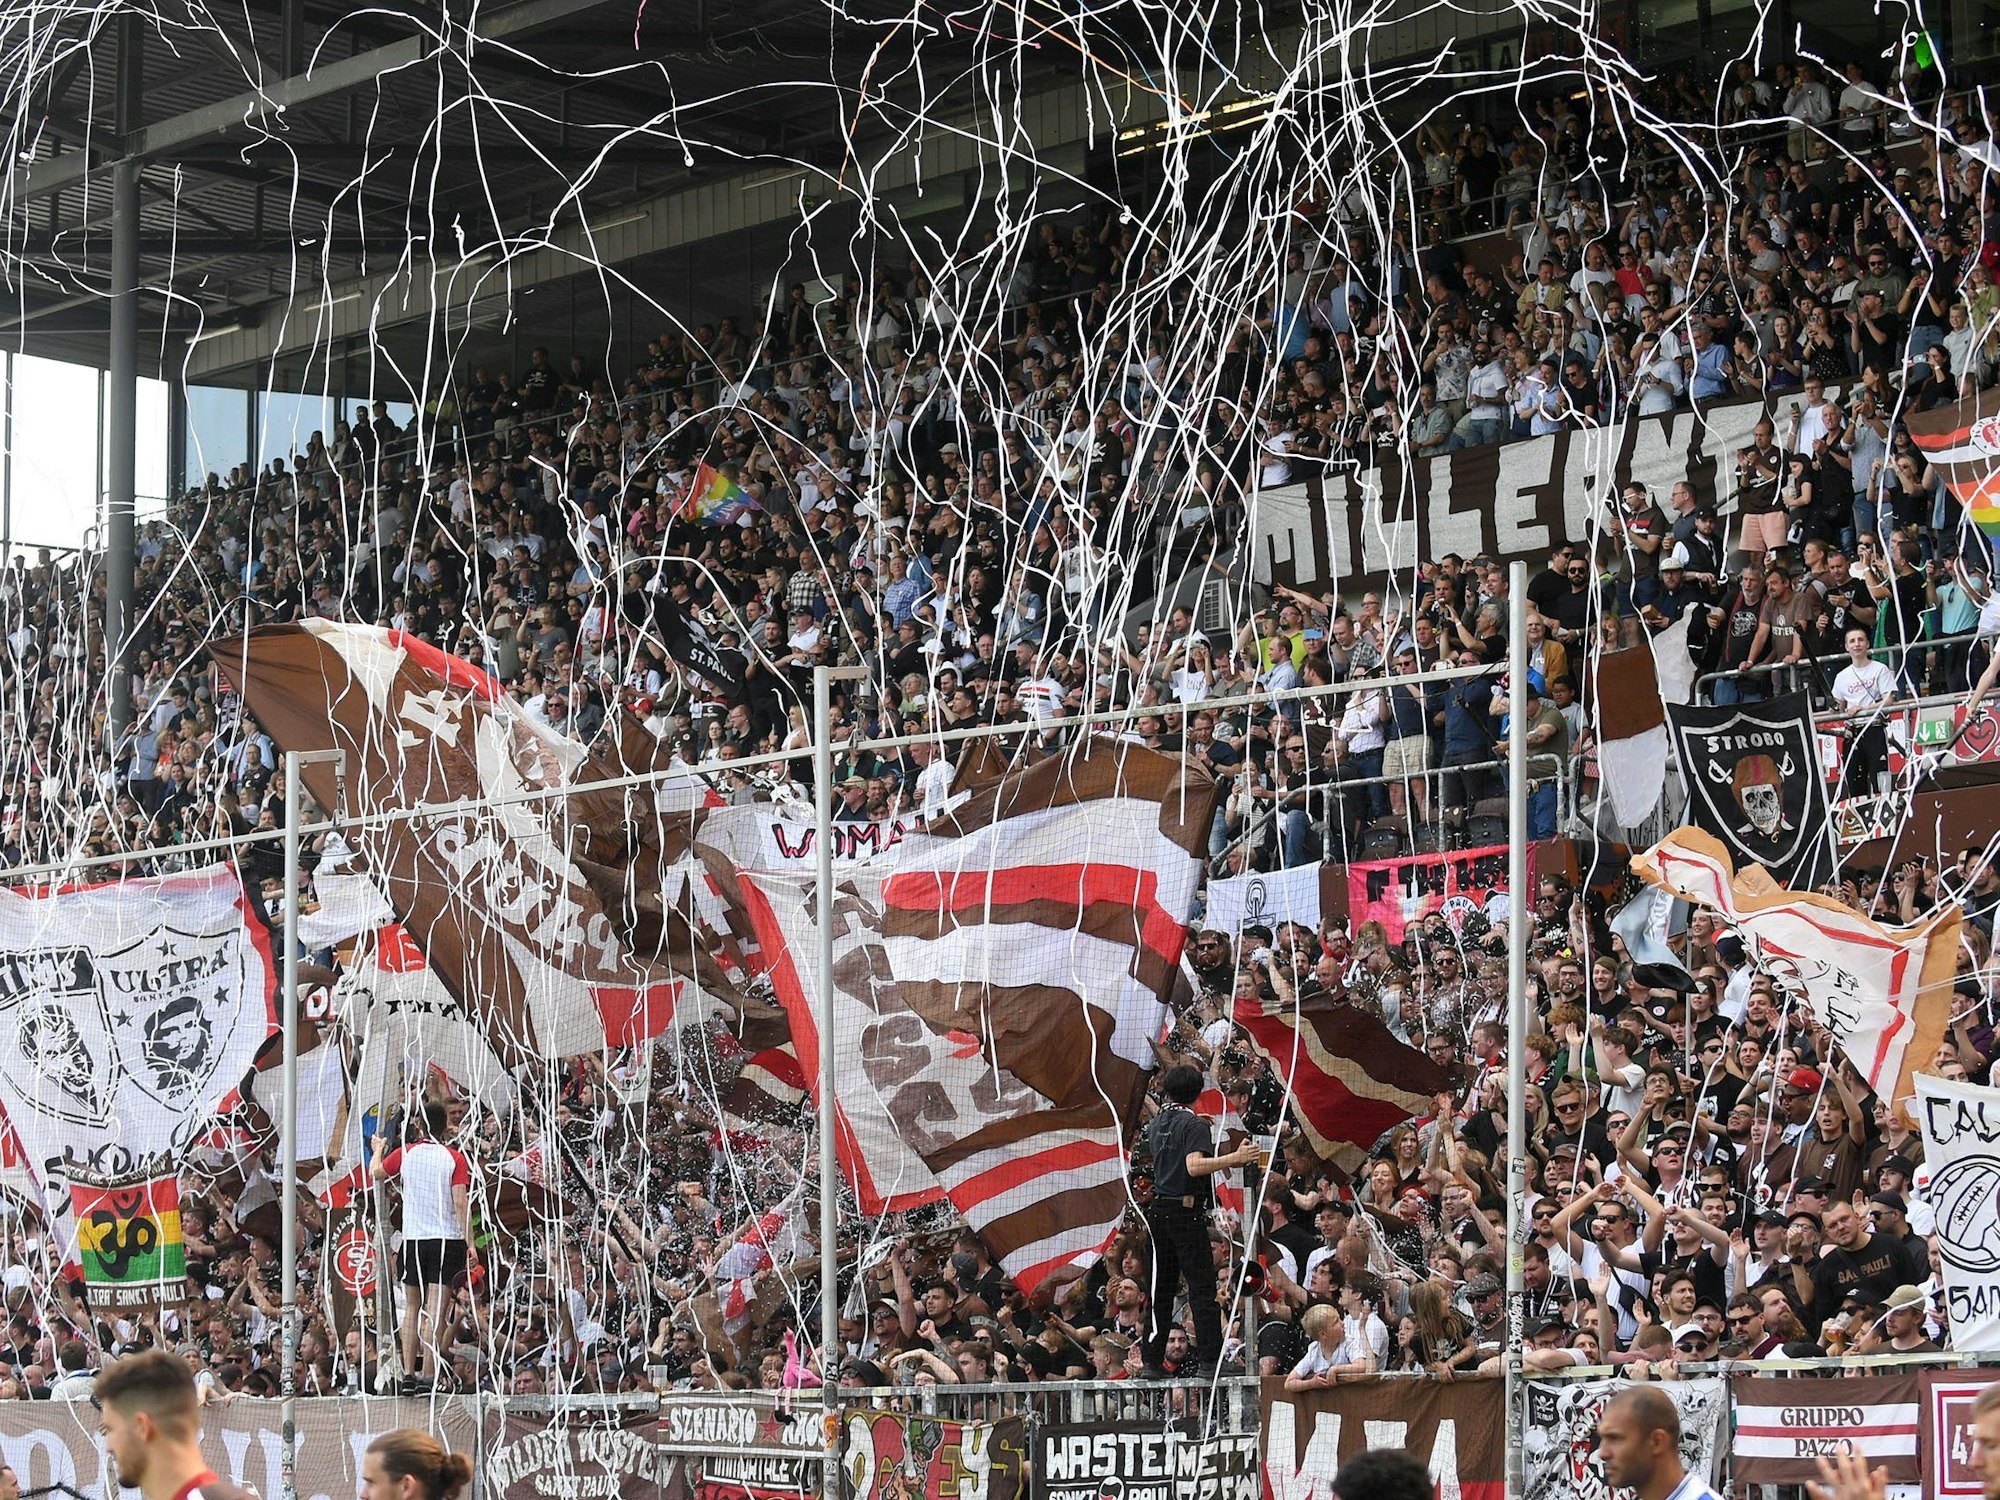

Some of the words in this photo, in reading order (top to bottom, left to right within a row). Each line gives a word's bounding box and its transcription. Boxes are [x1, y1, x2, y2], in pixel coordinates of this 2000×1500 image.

[1703, 732, 1785, 754] STROBO
[116, 1286, 149, 1306] SANKT
[669, 1406, 757, 1445] SZENARIO
[1781, 1408, 1865, 1427] GRUPPO
[1178, 1436, 1257, 1477] METT
[1794, 1438, 1854, 1458] PAZZO
